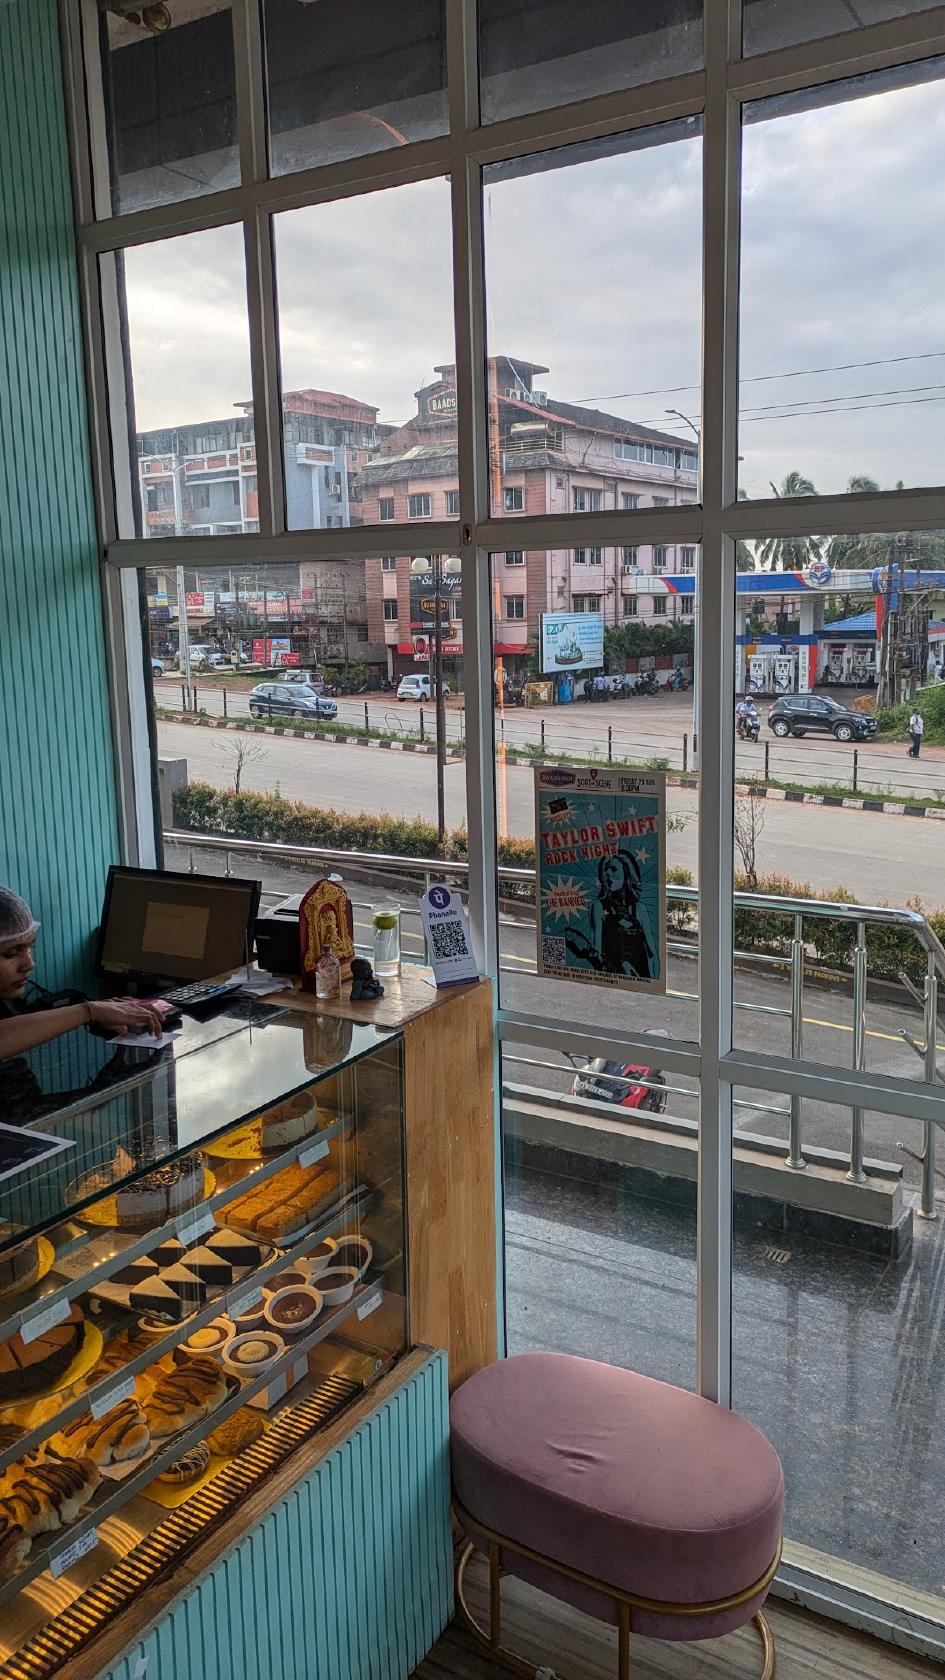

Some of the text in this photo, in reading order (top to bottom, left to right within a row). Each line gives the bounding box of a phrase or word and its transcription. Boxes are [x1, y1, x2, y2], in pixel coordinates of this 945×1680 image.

[432, 398, 456, 411] BAADS
[541, 816, 656, 849] TAYLOR SWIFT
[545, 842, 618, 865] ROCK NIGHT
[546, 895, 585, 907] THE BANNED
